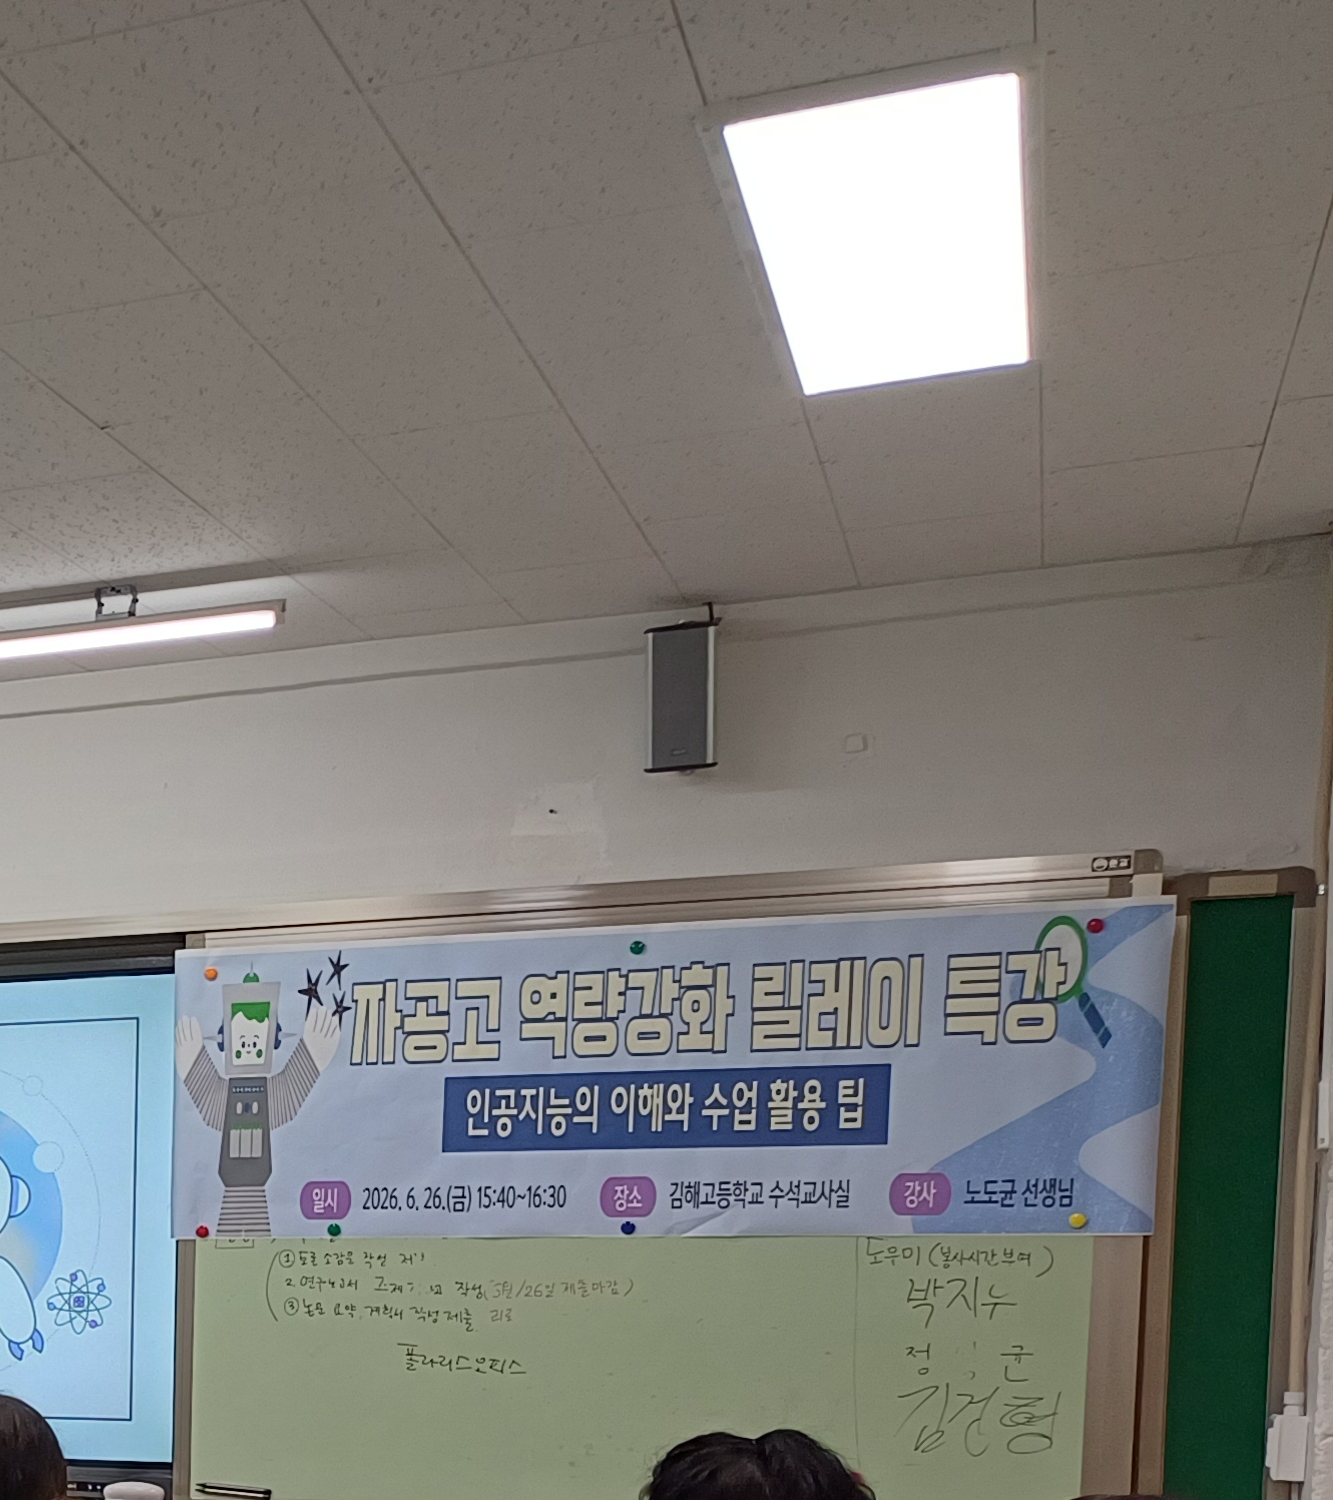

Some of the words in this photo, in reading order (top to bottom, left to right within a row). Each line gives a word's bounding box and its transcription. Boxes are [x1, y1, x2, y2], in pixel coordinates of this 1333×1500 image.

[350, 976, 503, 1066] 자공고
[519, 961, 735, 1058] 역량강화
[750, 953, 925, 1053] 릴레이
[944, 947, 1069, 1045] 특강
[466, 1085, 599, 1137] 인공지능의
[610, 1083, 694, 1133] 이해와
[701, 1081, 759, 1132] 수업
[767, 1078, 827, 1132] 활용
[837, 1077, 866, 1130] 팁
[312, 1187, 338, 1213] 일시
[362, 1187, 402, 1211] 2026.
[406, 1187, 419, 1211] 6.
[476, 1184, 567, 1210] 15:40~16:30
[613, 1185, 642, 1211] 장소
[669, 1180, 764, 1209] 김해고등학교
[768, 1179, 851, 1209] 수석교사실
[903, 1181, 936, 1209] 강사
[963, 1180, 1017, 1208] 노도균
[1020, 1177, 1074, 1208] 선생님
[866, 1237, 921, 1266] 도우미
